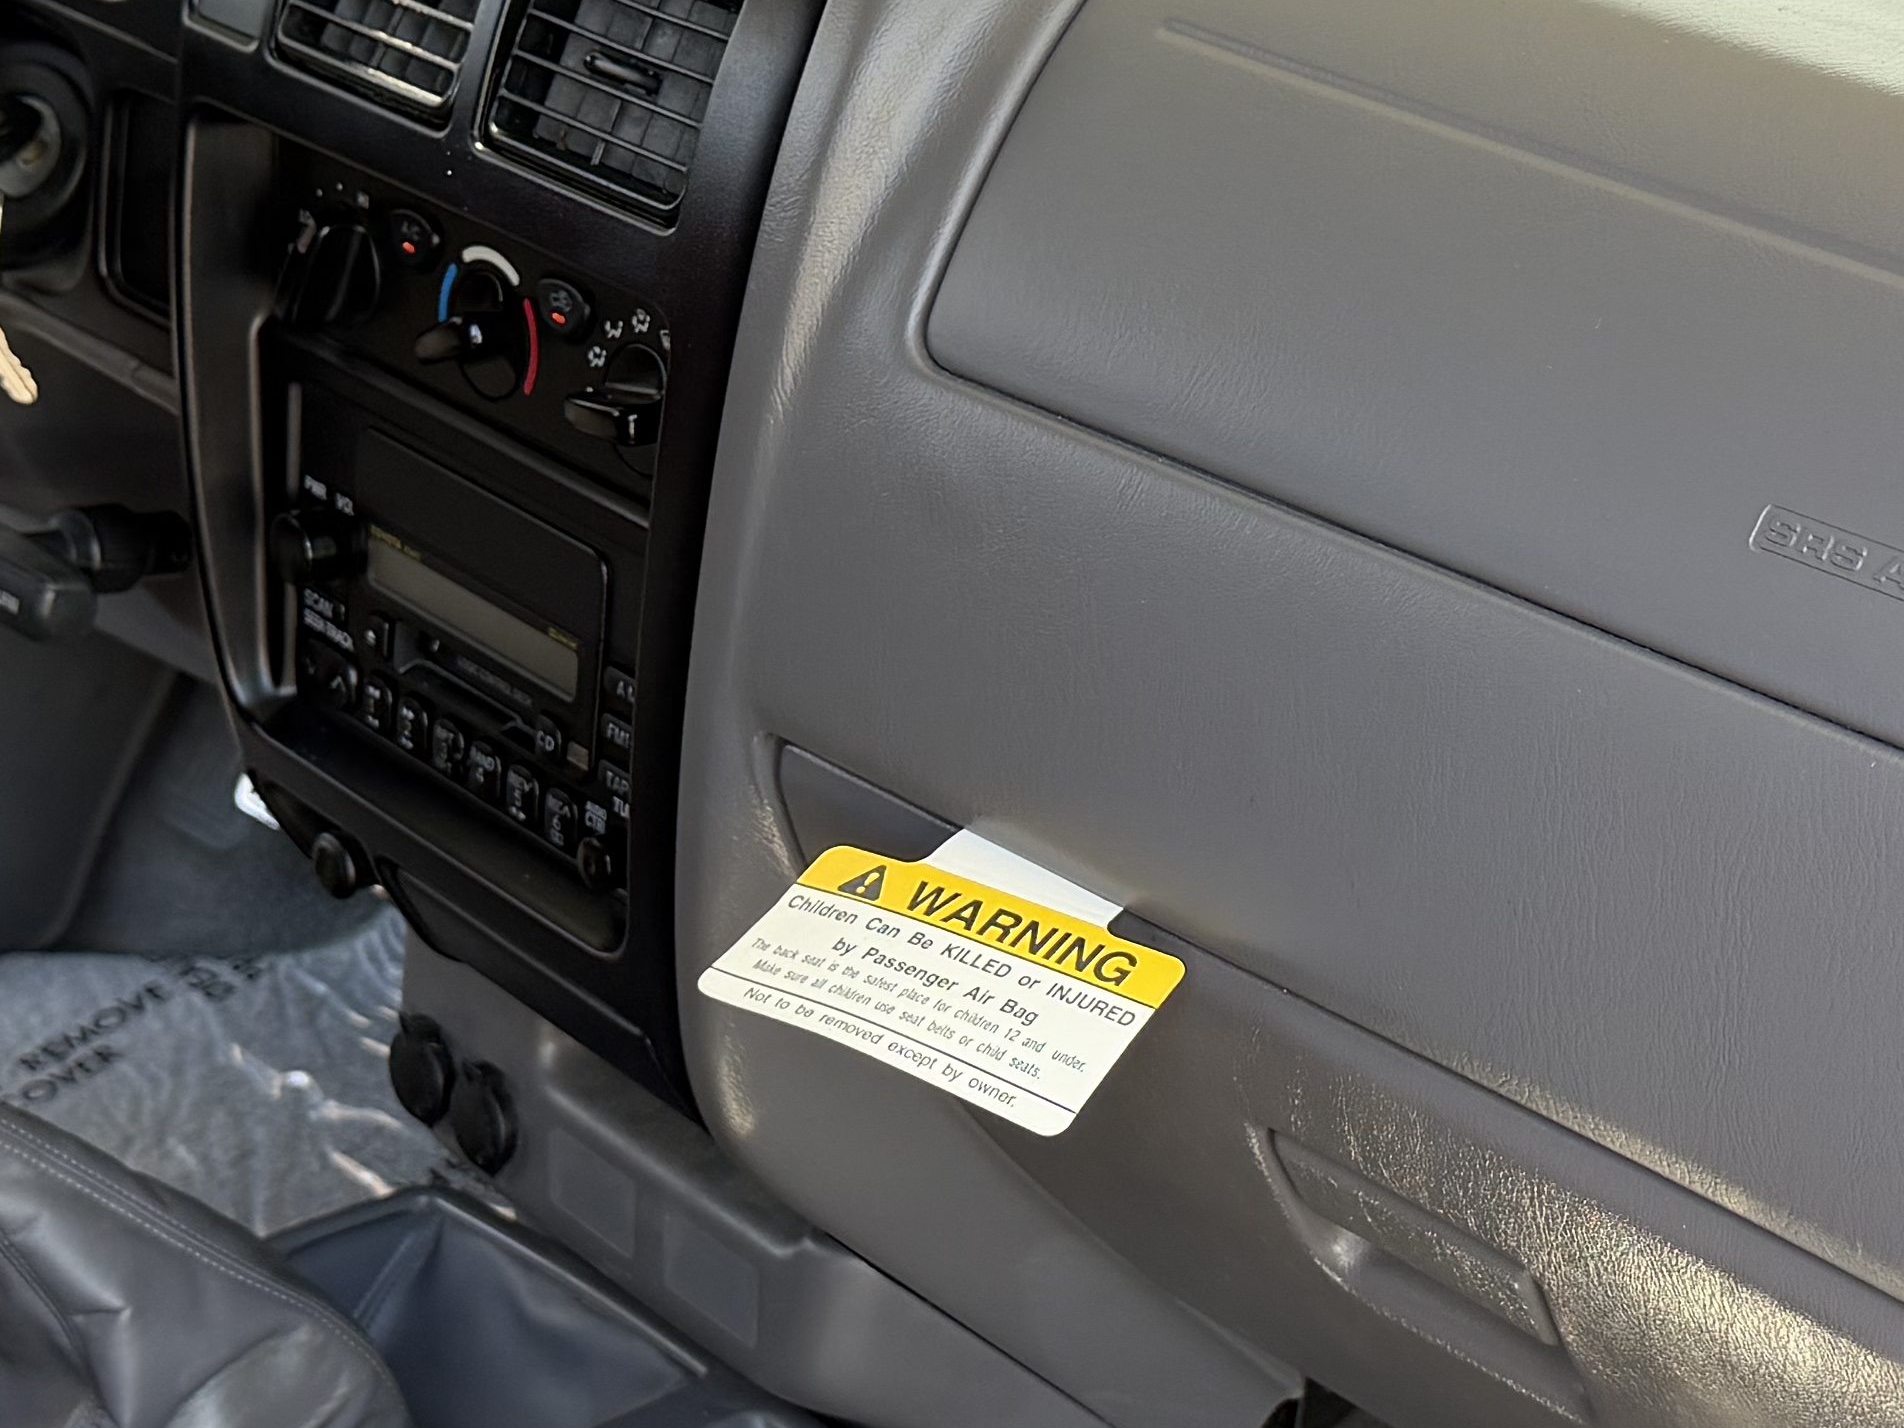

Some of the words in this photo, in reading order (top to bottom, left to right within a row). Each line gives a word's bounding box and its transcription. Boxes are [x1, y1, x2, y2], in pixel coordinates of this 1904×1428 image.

[1763, 513, 1868, 573] SRS
[536, 730, 555, 752] CD
[606, 770, 631, 796] TAP
[788, 894, 859, 925] Children
[865, 917, 901, 939] Can
[907, 932, 934, 950] Be
[940, 943, 1012, 979] KILLED
[1017, 974, 1041, 989] or
[1045, 982, 1137, 1029] INJURED
[831, 937, 858, 957] by
[862, 947, 960, 994] Passenger
[963, 985, 996, 1006] Air
[999, 998, 1040, 1027] Bag
[908, 880, 1139, 988] WARNING
[744, 986, 772, 1005] Not
[774, 994, 792, 1011] to
[795, 1003, 814, 1019] be
[818, 1012, 886, 1046] removed
[887, 1040, 939, 1071] except
[941, 1062, 964, 1084] by
[967, 1075, 1019, 1109] owner.
[751, 937, 771, 953] The
[772, 945, 799, 961] back
[801, 952, 827, 969] seat
[827, 959, 840, 972] is
[841, 965, 861, 979] the
[862, 974, 898, 993] safest
[900, 986, 932, 1007] place
[934, 997, 952, 1014] for
[953, 1008, 1000, 1034] children
[1003, 1026, 1022, 1044] 12
[1021, 1036, 1047, 1054] and
[1051, 1047, 1088, 1073] under.
[752, 958, 781, 977] Make
[786, 969, 808, 984] sure
[810, 976, 827, 990] all
[829, 982, 873, 1006] children
[874, 999, 897, 1015] use
[899, 1010, 923, 1028] seat
[926, 1018, 955, 1041] belts
[958, 1032, 975, 1047] or
[976, 1040, 1007, 1062] child
[1008, 1054, 1042, 1080] seats.
